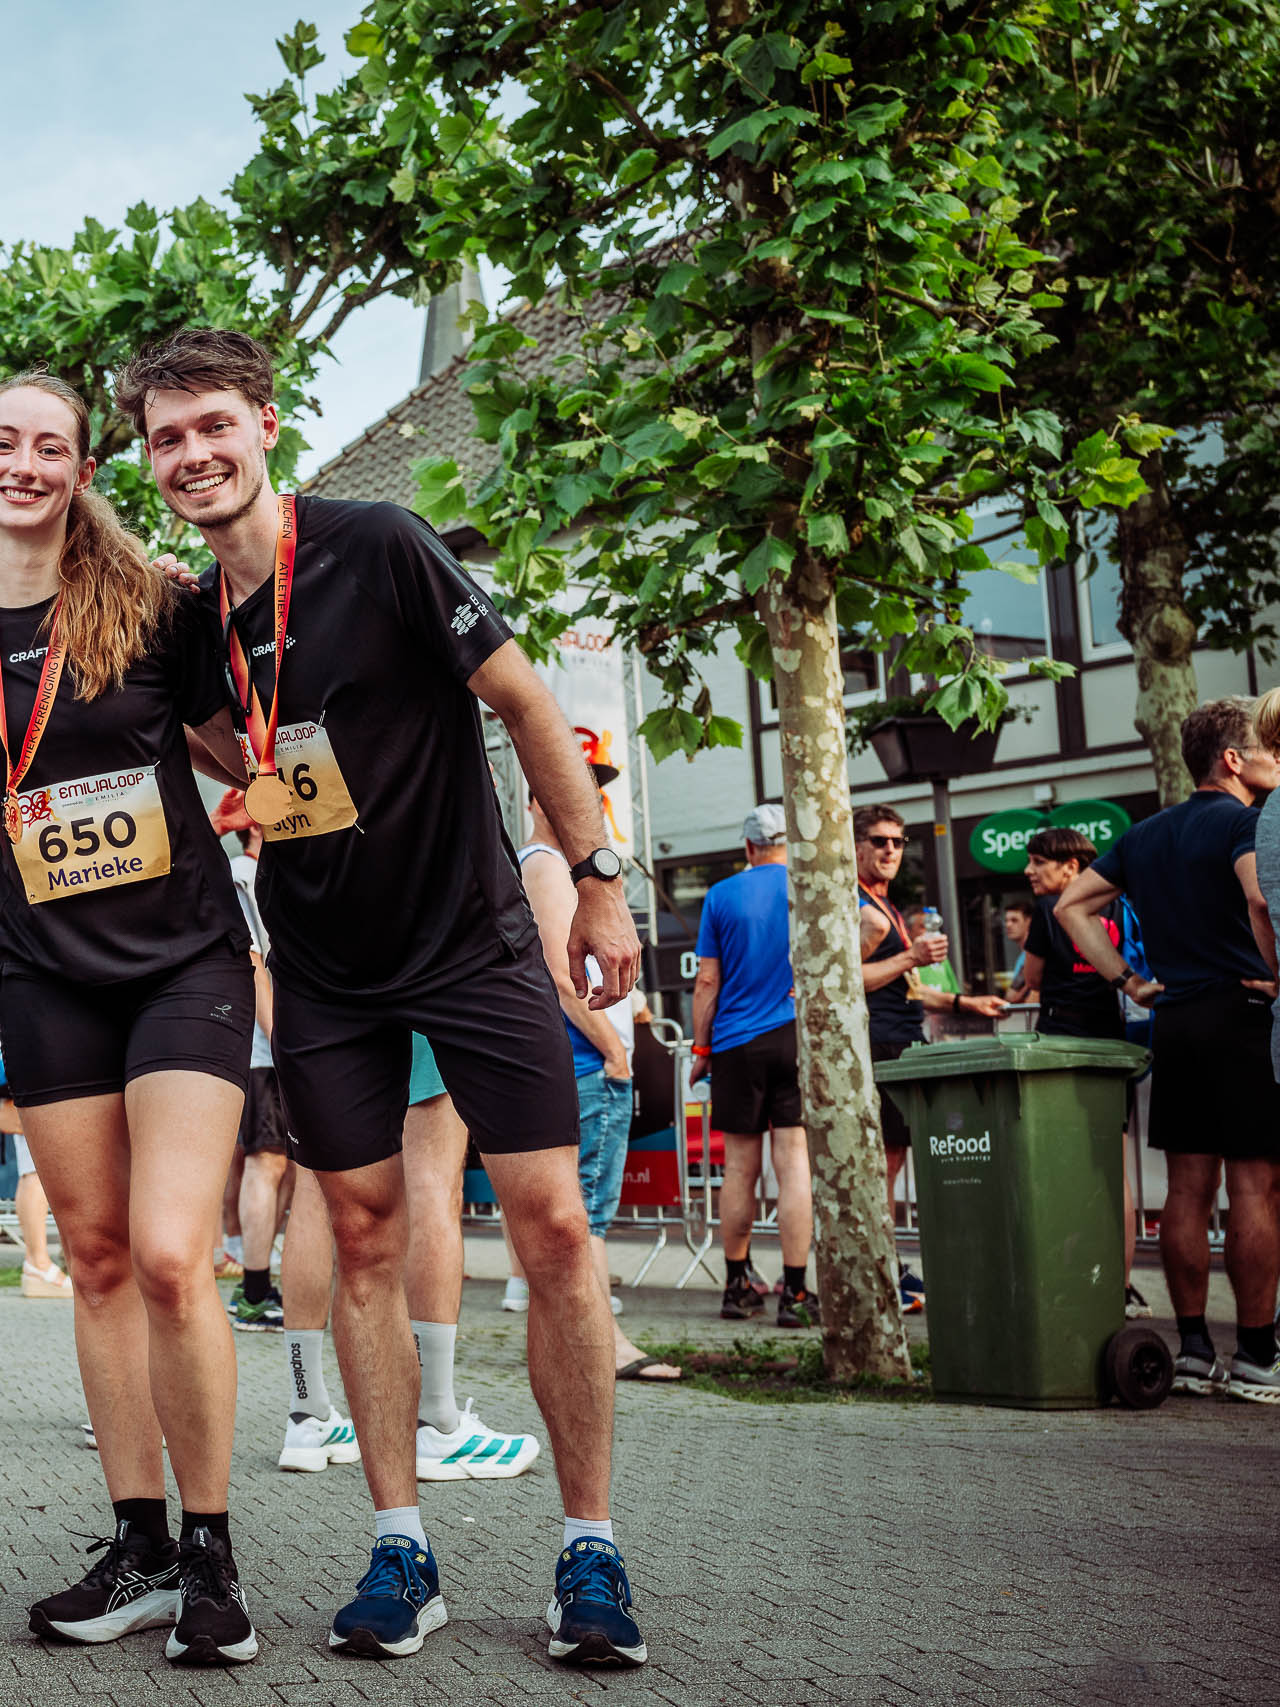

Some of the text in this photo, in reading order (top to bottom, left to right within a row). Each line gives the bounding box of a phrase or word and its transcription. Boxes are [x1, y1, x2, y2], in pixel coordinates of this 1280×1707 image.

[277, 562, 289, 620] ATLETIEK
[9, 646, 49, 663] CRAFT
[252, 641, 277, 657] CRAF
[30, 662, 59, 732] VERENIGING
[58, 772, 144, 799] EMILIALOOP
[38, 810, 137, 864] 650
[47, 856, 143, 891] Marieke
[929, 1130, 991, 1157] ReFood
[624, 1167, 650, 1184] n.nl
[290, 1342, 308, 1399] souplesse
